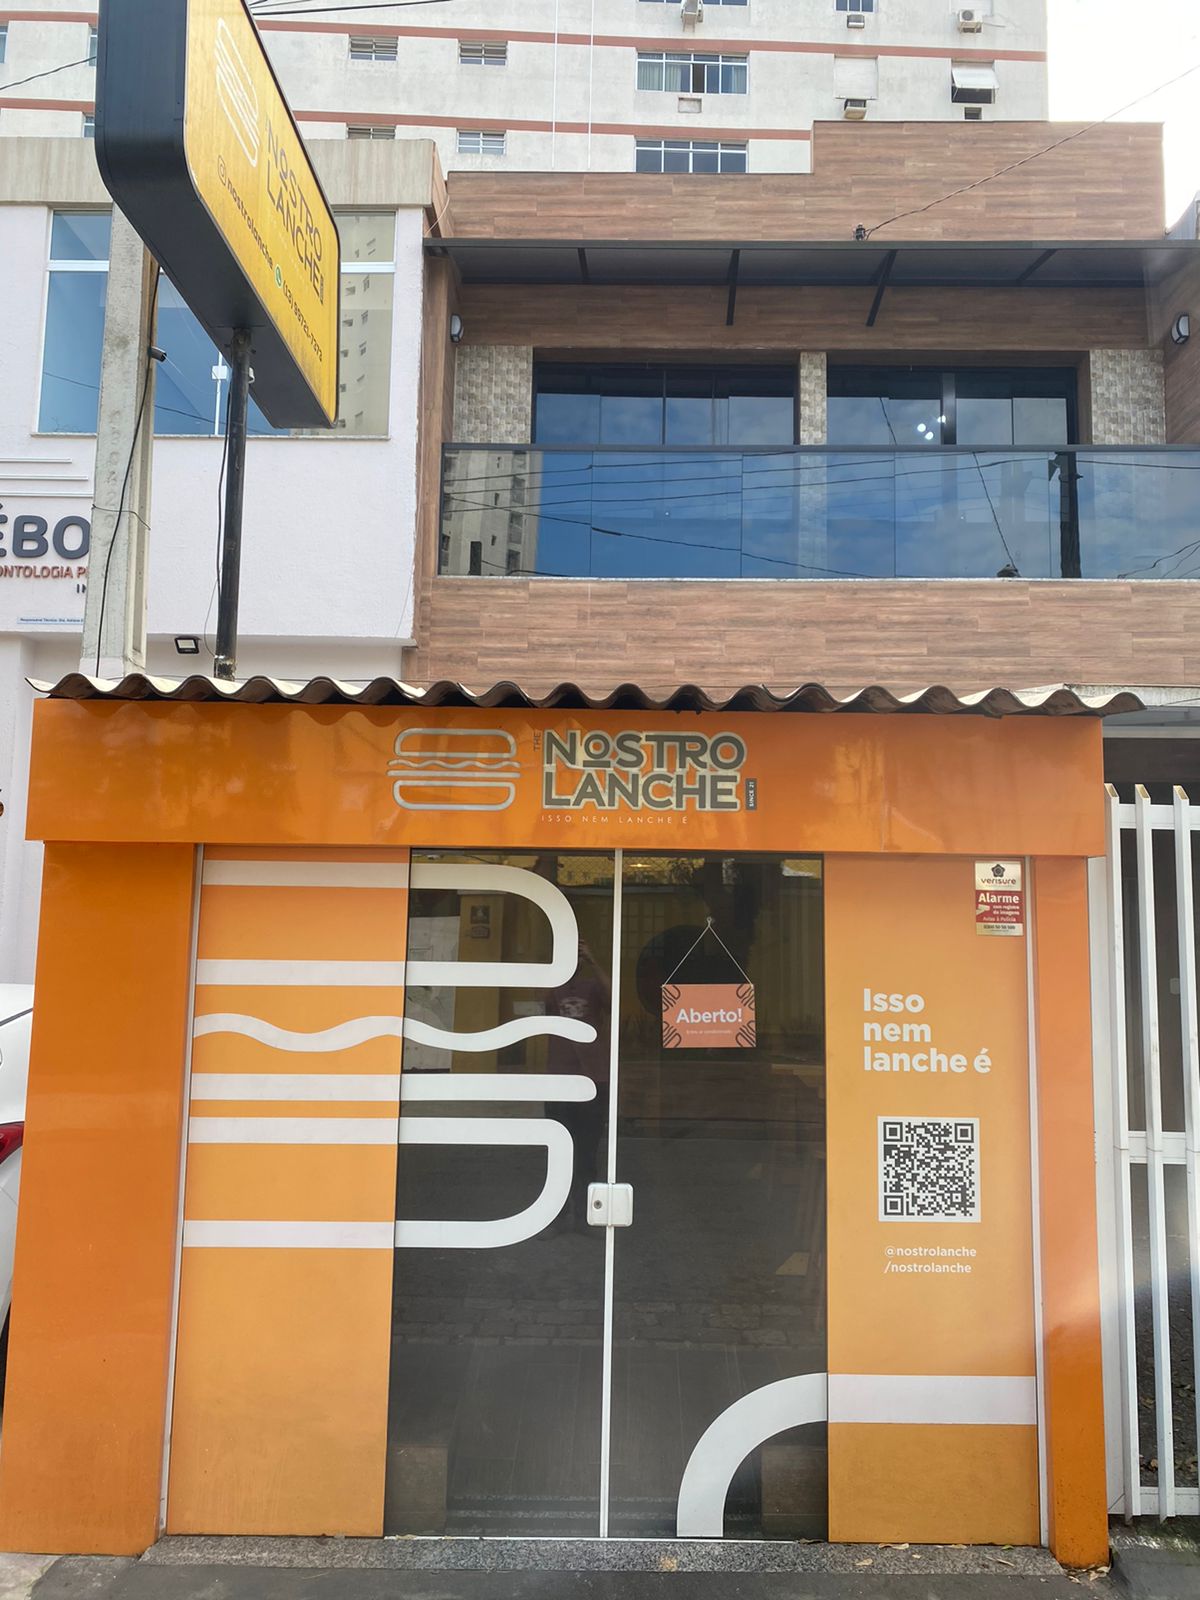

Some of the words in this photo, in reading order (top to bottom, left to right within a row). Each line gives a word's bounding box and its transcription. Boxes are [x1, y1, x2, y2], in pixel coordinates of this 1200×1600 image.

[267, 119, 323, 262] NOSTRO
[227, 177, 273, 270] nostrolanche
[267, 159, 321, 298] LANCHE
[0, 502, 91, 560] BO
[533, 729, 541, 752] THE
[545, 730, 746, 770] NOSTRO
[544, 771, 740, 808] LANCHE
[541, 815, 572, 823] ISSO
[582, 815, 609, 823] NEM
[618, 816, 672, 824] LANCHE
[978, 892, 1020, 904] Alarme
[863, 988, 925, 1013] Isso
[676, 1008, 743, 1023] Aberto!
[863, 1022, 932, 1042] nem
[863, 1046, 968, 1073] lanche
[973, 1047, 992, 1073] é
[884, 1245, 977, 1258] @nostrolanche
[883, 1260, 972, 1274] /nostrolanche
